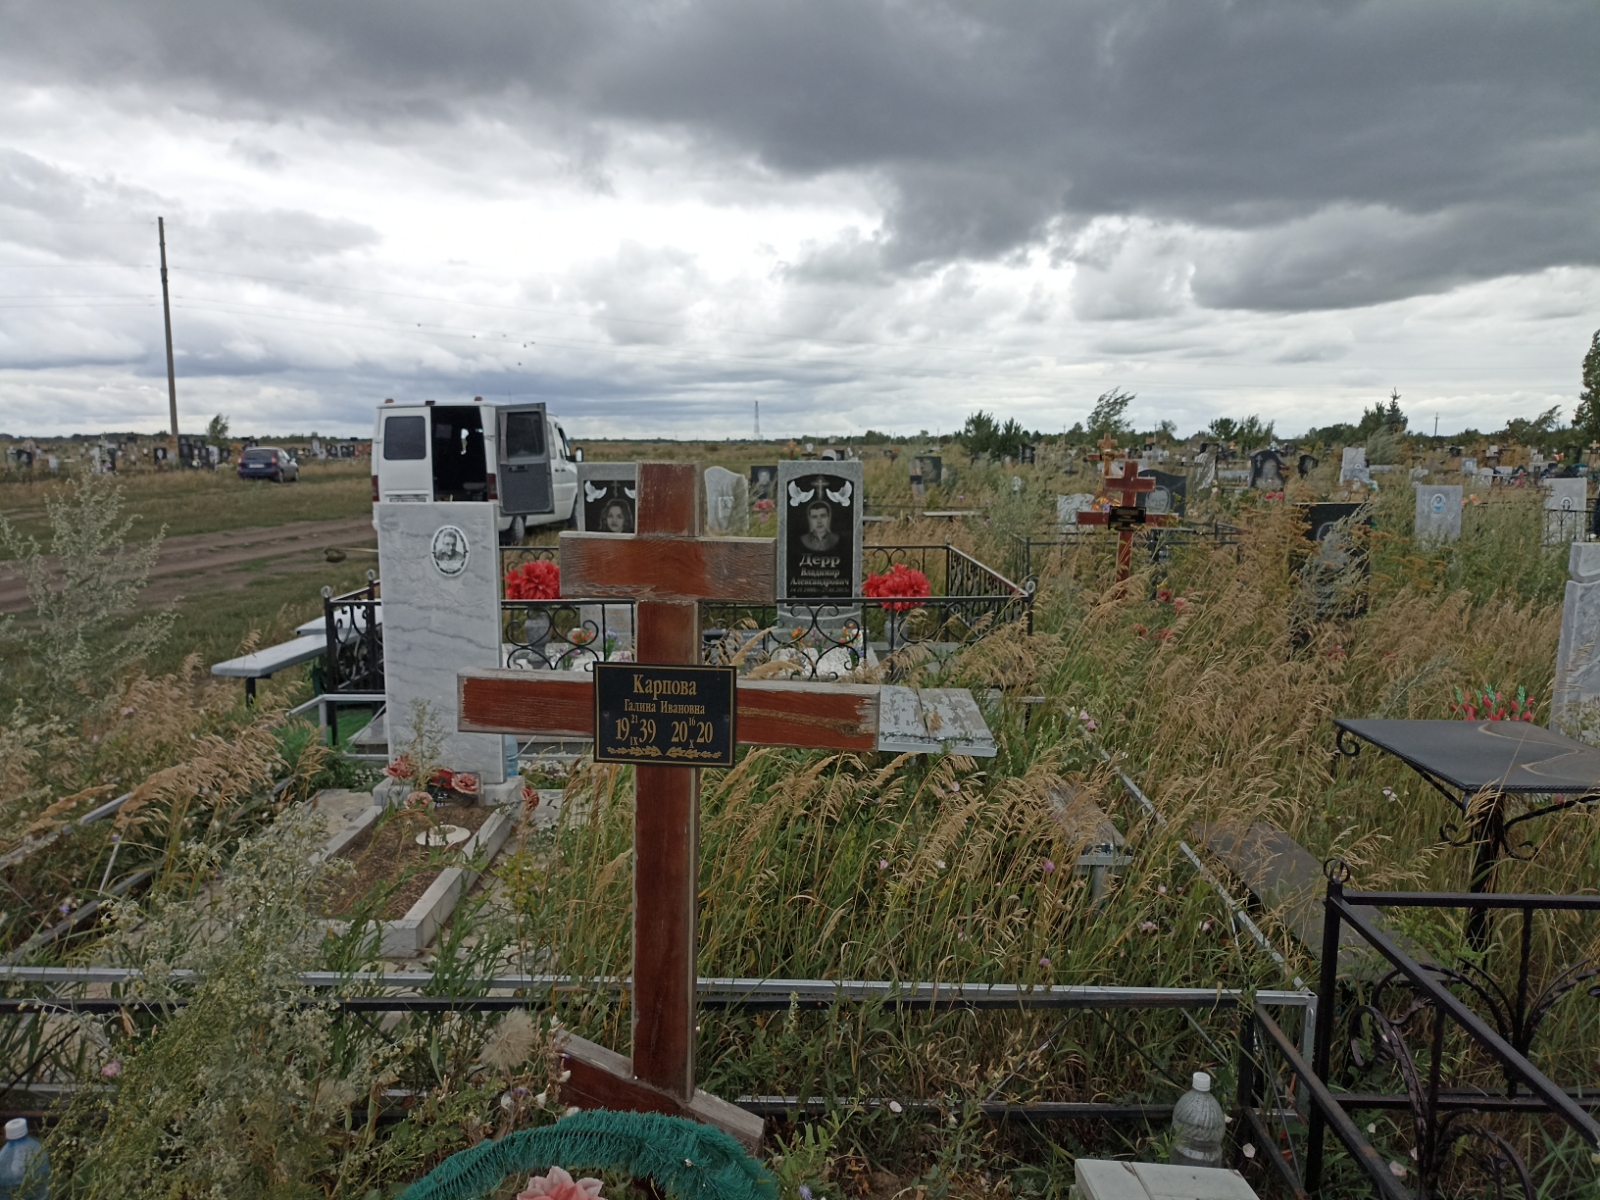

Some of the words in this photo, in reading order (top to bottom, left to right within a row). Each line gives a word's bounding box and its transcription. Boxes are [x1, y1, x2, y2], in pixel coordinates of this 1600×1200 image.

[799, 553, 840, 567] Дерр
[633, 674, 697, 700] Карпова
[624, 698, 656, 713] Галина
[660, 700, 705, 715] Ивановна
